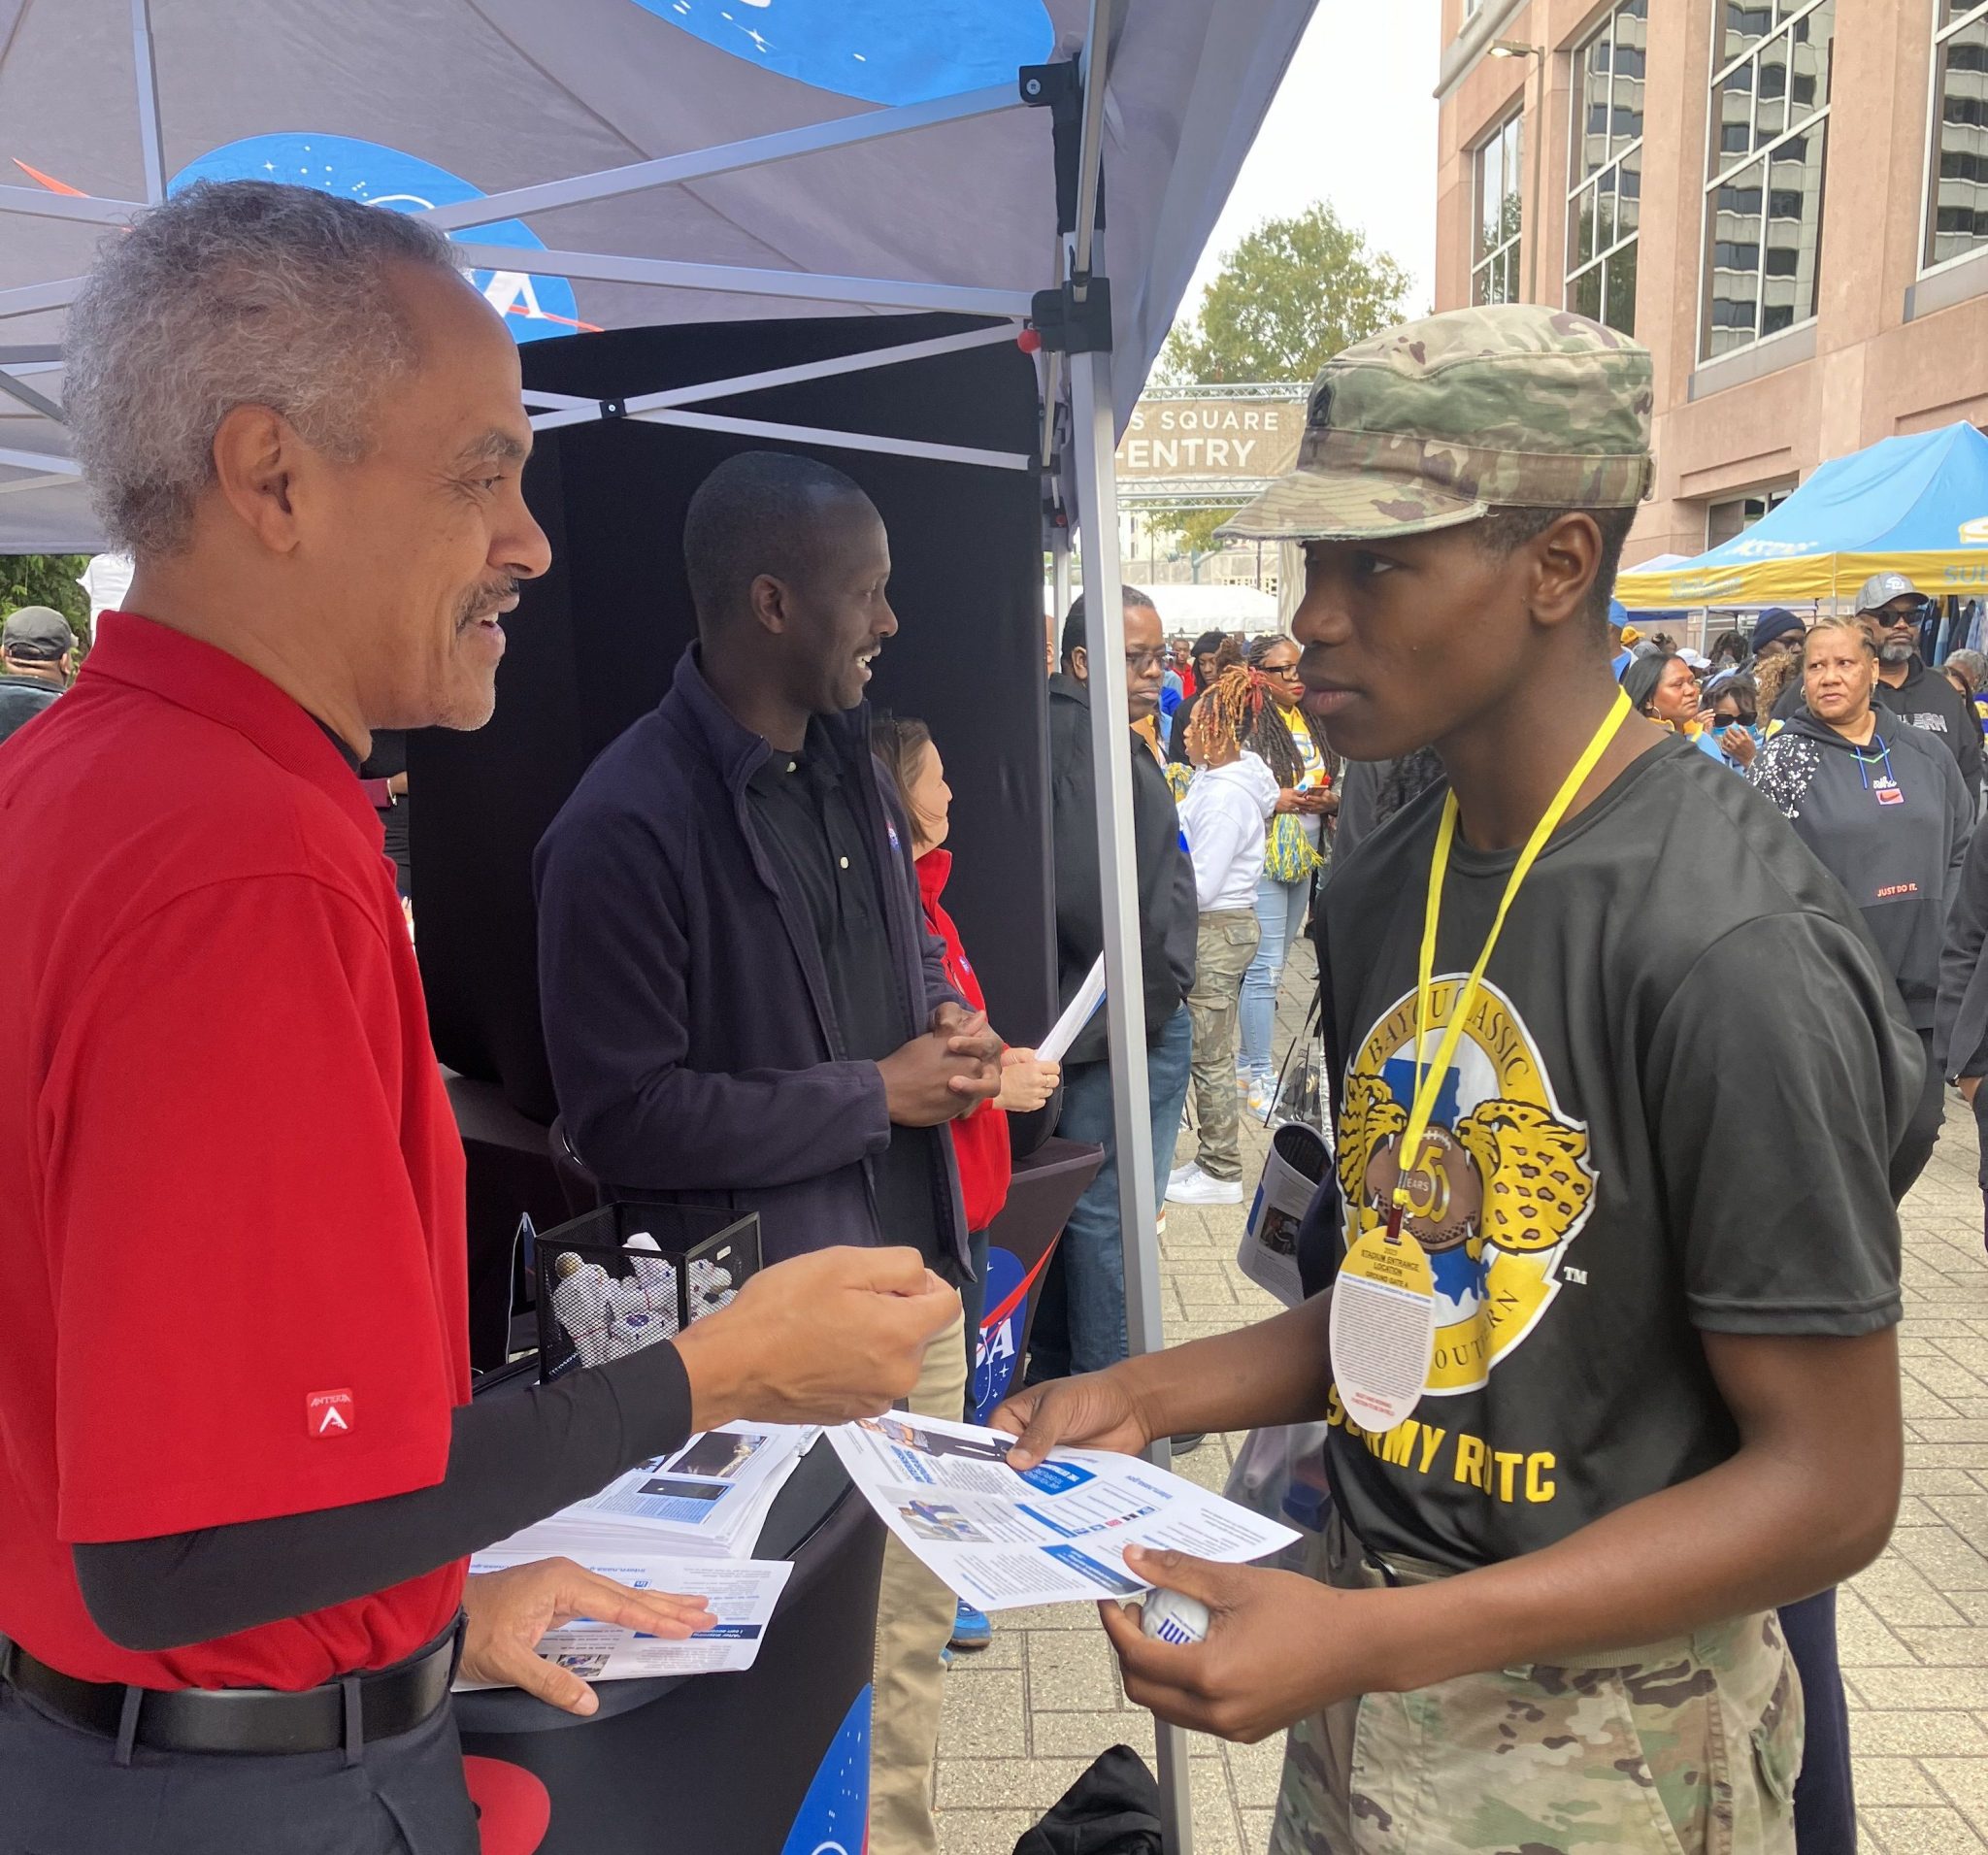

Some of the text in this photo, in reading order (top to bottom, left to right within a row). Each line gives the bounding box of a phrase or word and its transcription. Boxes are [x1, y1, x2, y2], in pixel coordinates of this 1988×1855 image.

[1131, 411, 1279, 431] S SQUARE
[1114, 438, 1257, 468] -ENTRY
[1876, 886, 1895, 898] JUST
[1897, 884, 1907, 893] DO
[1407, 1177, 1429, 1192] EARS
[1374, 1261, 1403, 1276] LOCATION
[1563, 1266, 1588, 1285] TM
